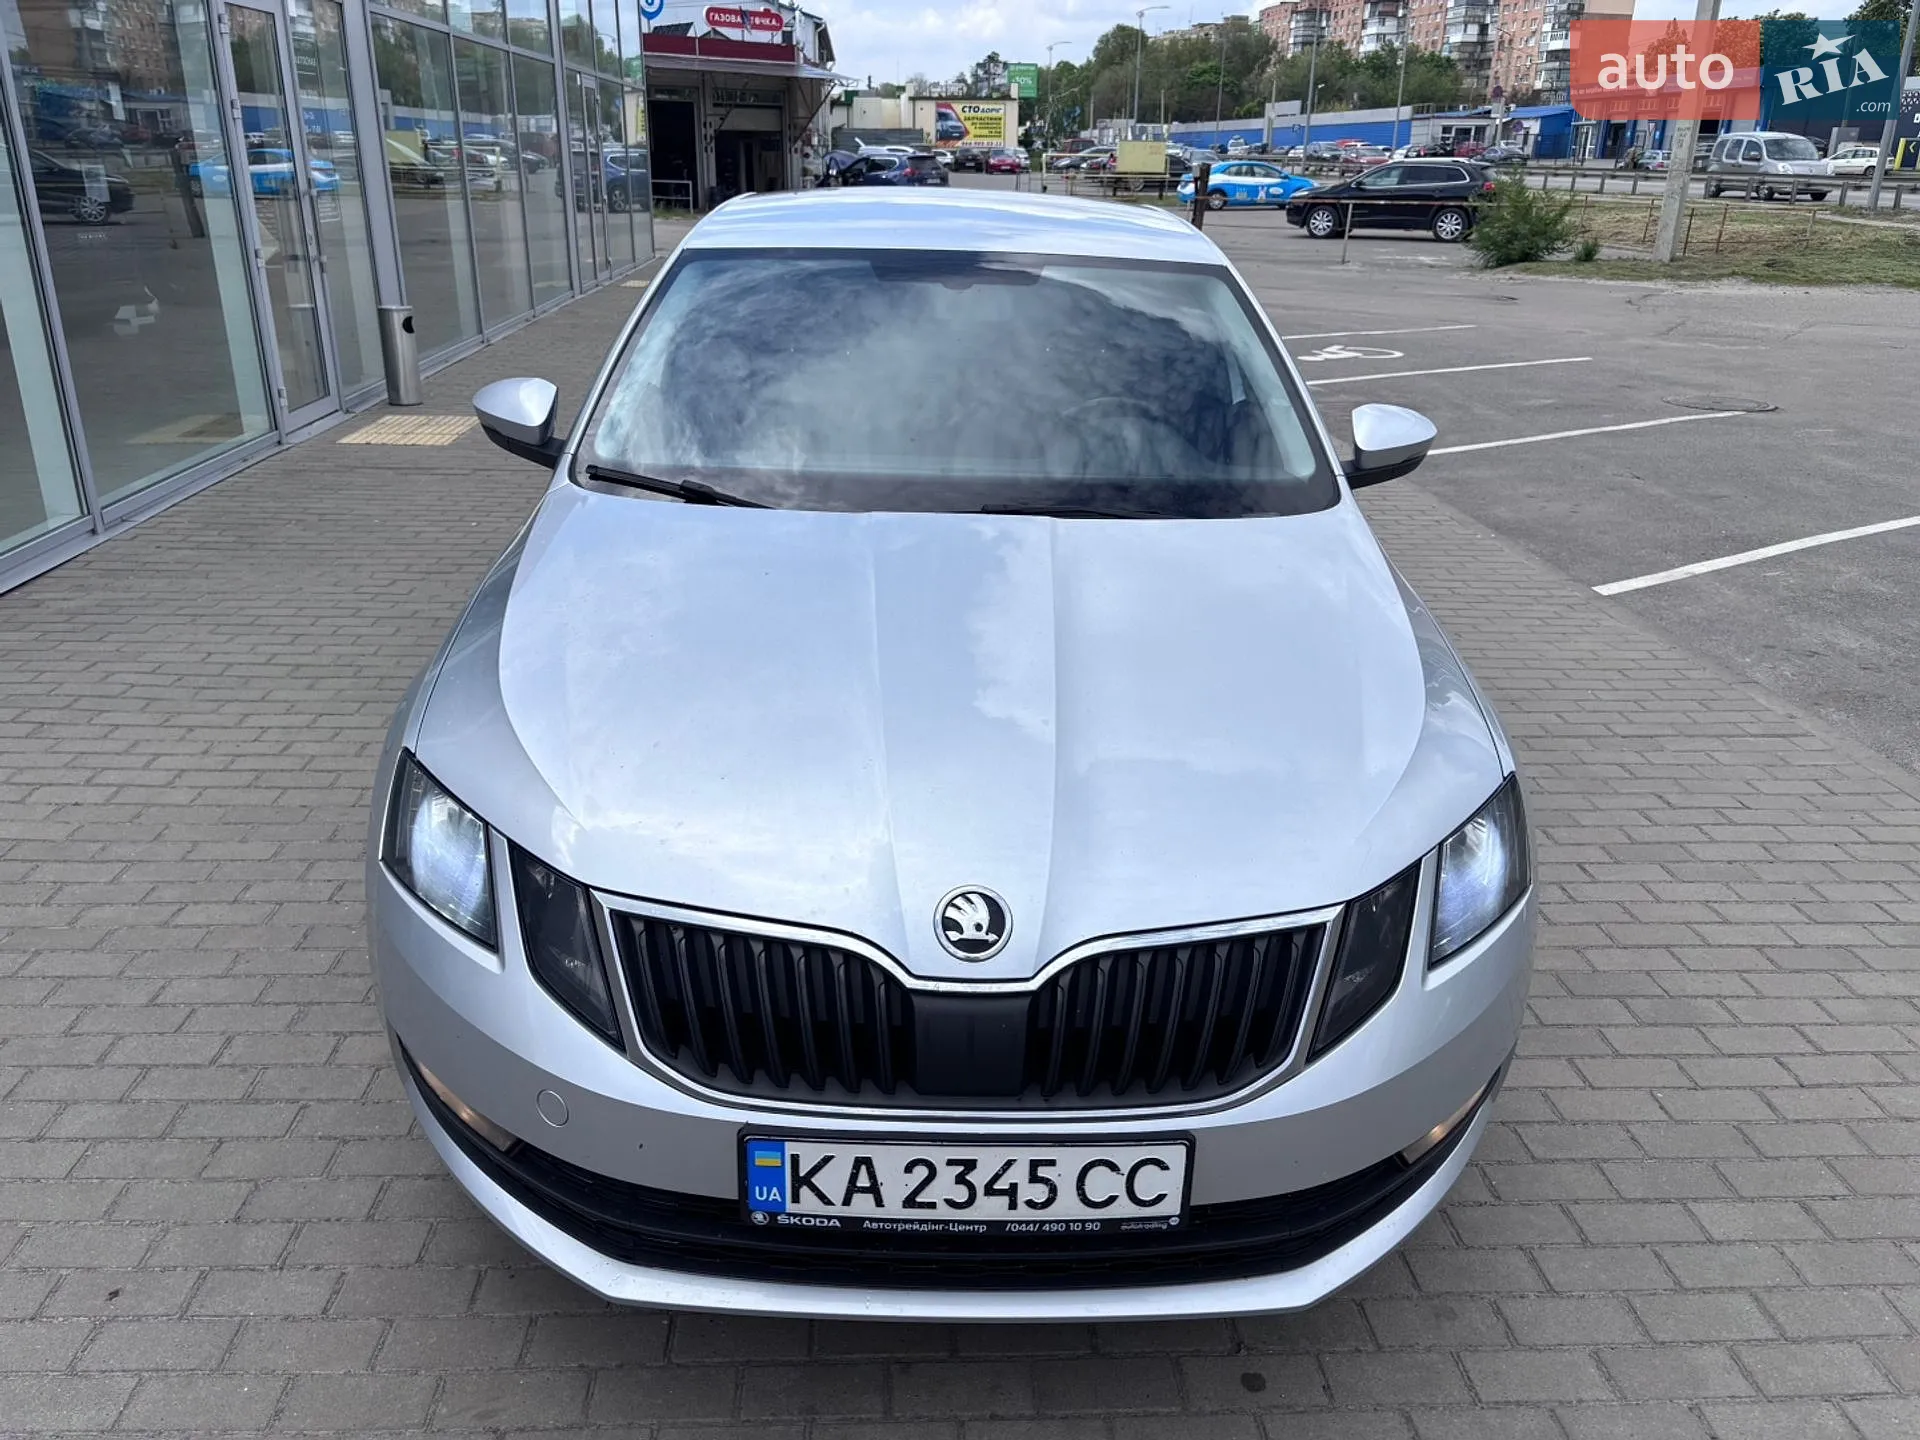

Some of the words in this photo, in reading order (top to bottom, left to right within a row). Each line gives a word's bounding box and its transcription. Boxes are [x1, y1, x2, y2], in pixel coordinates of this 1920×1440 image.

[709, 12, 742, 24] ГАЗОВА
[961, 105, 980, 113] СТО
[790, 1153, 885, 1207] KA
[902, 1158, 1058, 1210] 2345
[1076, 1157, 1171, 1208] CC
[755, 1185, 782, 1202] UA
[777, 1214, 841, 1227] ŠKODA
[863, 1220, 987, 1232] Автотрейдінг-Центр
[1005, 1222, 1039, 1232] /044/
[1042, 1222, 1066, 1231] 490
[1069, 1223, 1082, 1231] 10
[1084, 1222, 1101, 1230] 90
